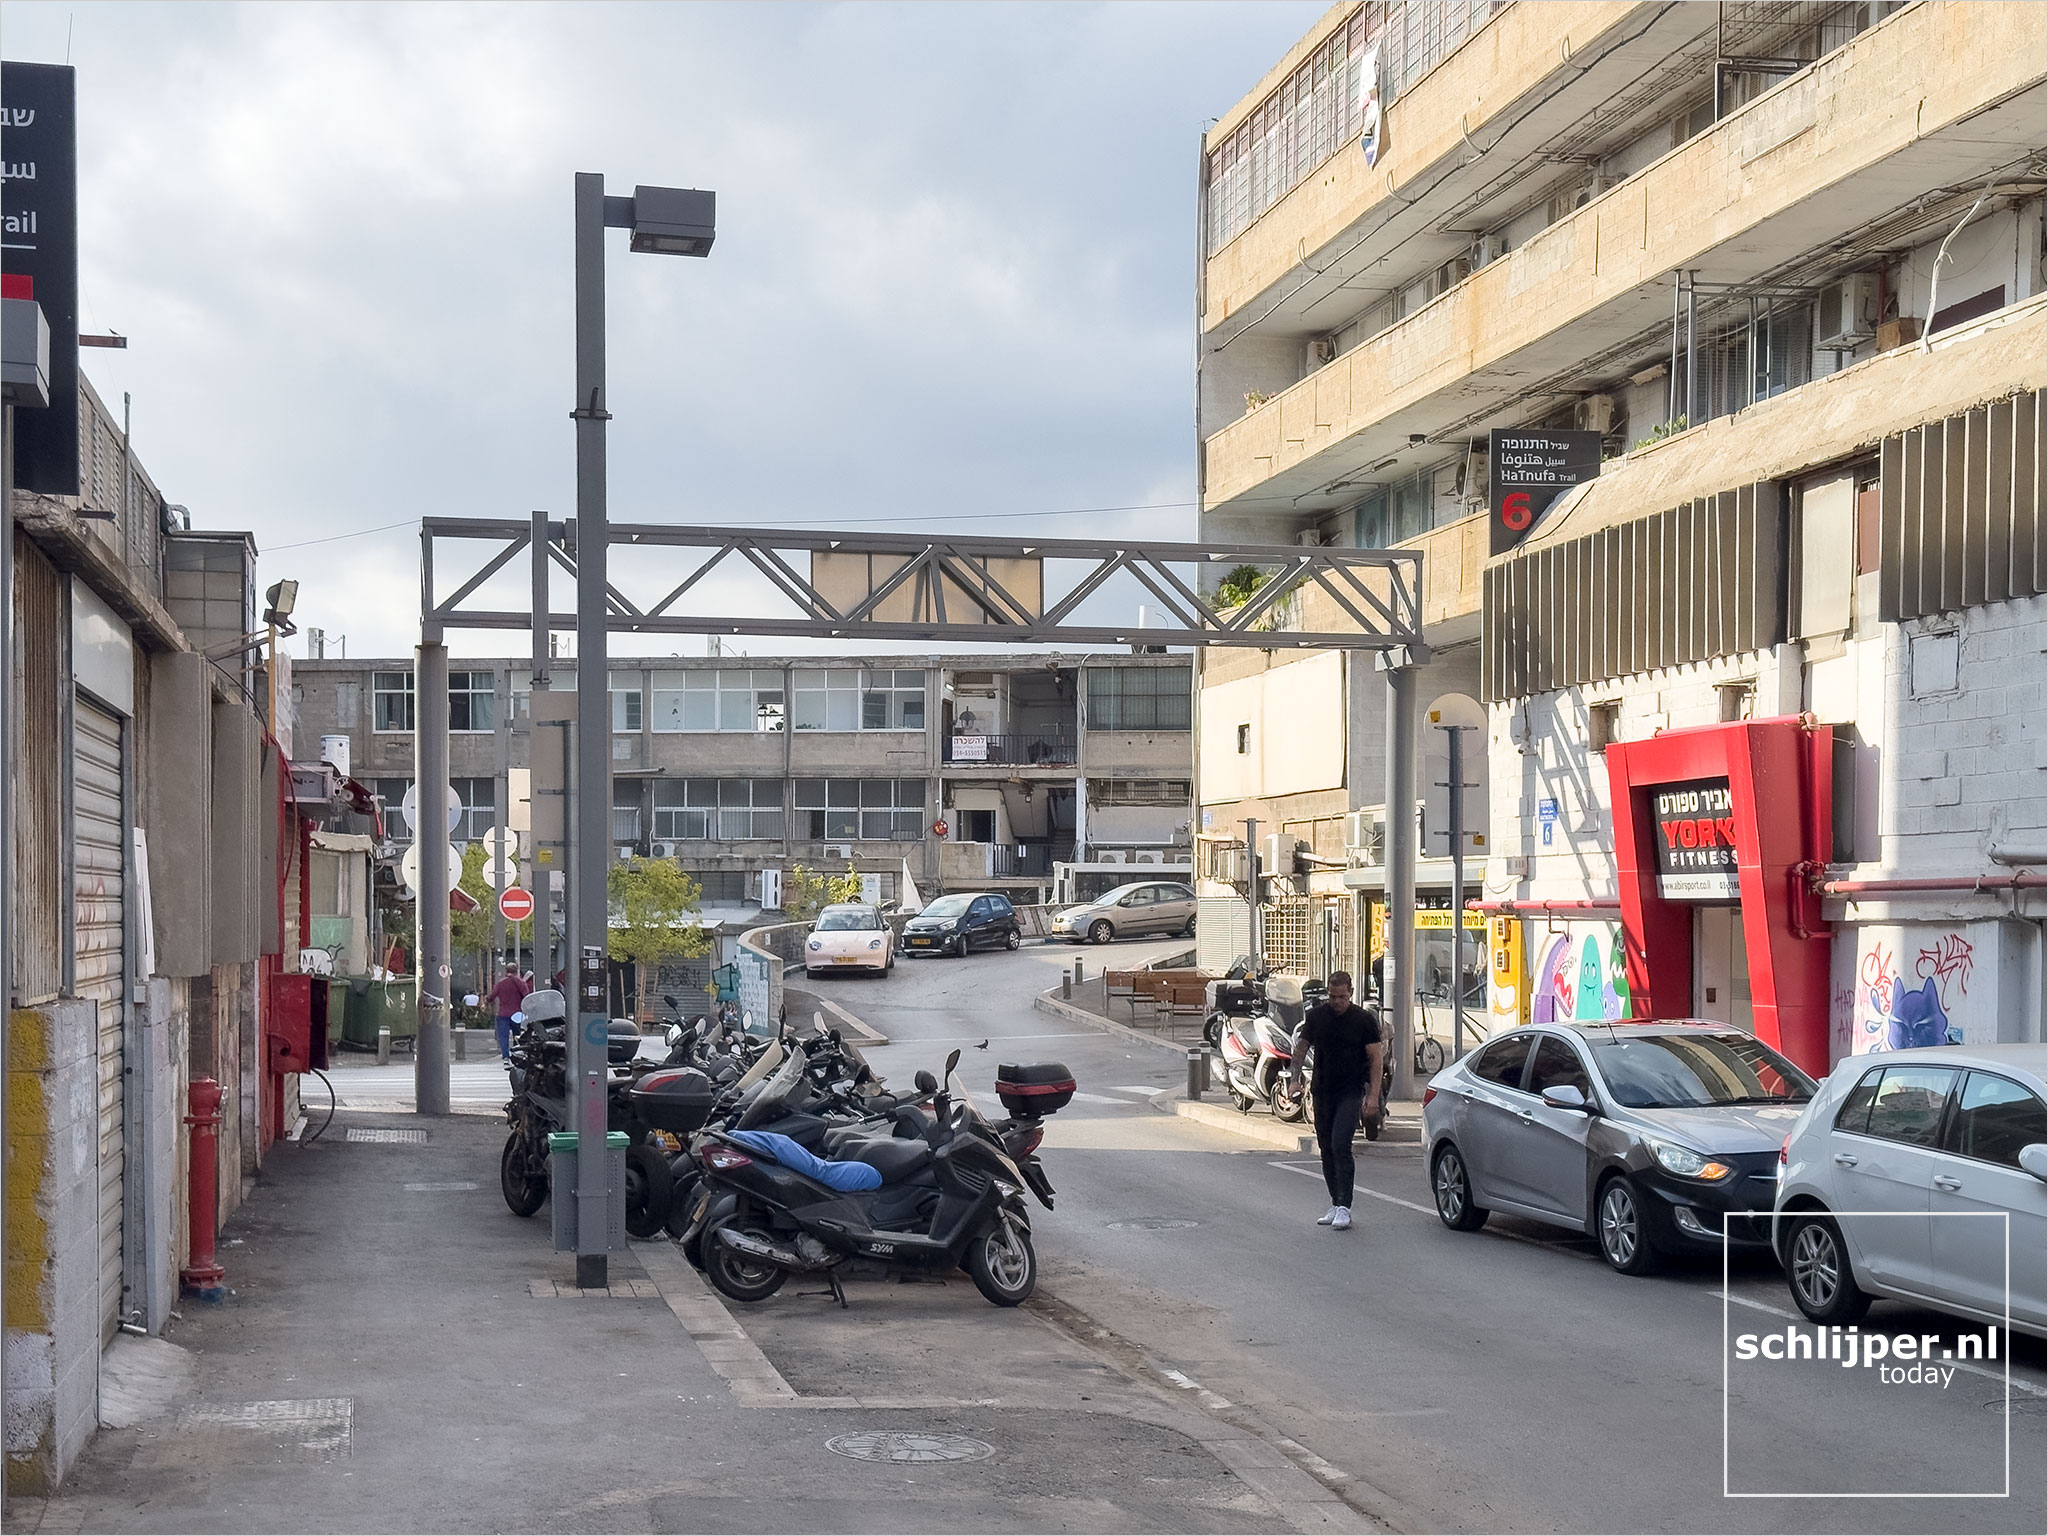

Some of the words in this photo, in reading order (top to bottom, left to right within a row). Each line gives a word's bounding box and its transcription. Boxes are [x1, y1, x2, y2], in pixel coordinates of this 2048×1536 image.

[1501, 439, 1549, 450] התנופה
[1550, 442, 1570, 450] שביל
[1501, 452, 1543, 468] هتنوفا
[1545, 457, 1566, 467] سبيل
[1501, 469, 1556, 481] HaTnufa
[1559, 473, 1577, 481] Trail
[1501, 492, 1533, 531] 6
[1659, 791, 1699, 814] ספורט
[1701, 788, 1733, 811] אביר
[1661, 817, 1737, 848] YORK
[1669, 850, 1738, 867] FITNESS
[870, 1243, 894, 1254] SYM
